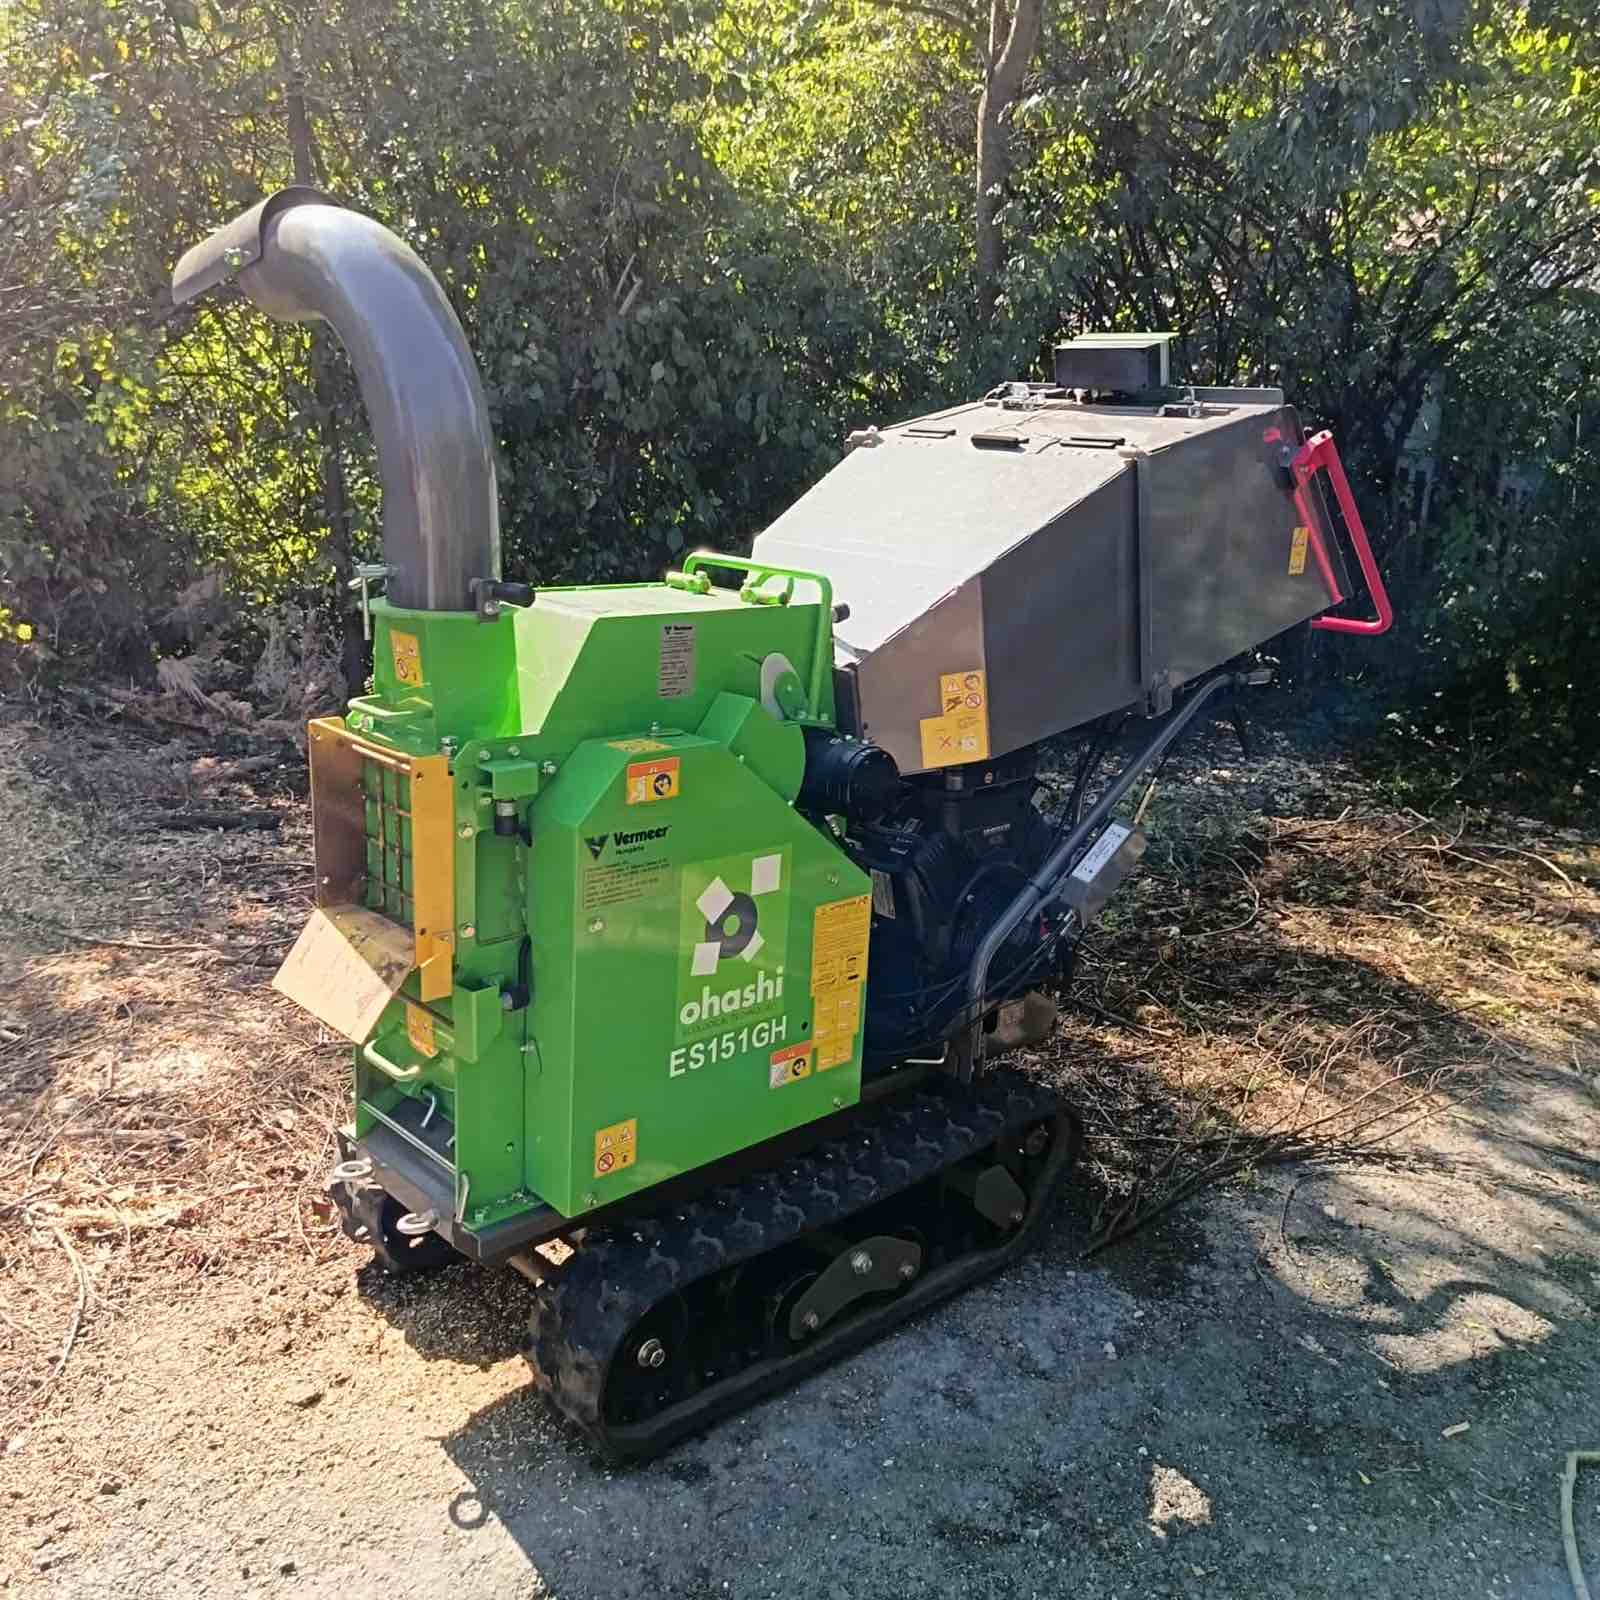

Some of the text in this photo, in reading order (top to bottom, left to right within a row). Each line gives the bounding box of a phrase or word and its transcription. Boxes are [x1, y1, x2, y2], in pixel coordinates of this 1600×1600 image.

[613, 826, 669, 846] Vermeer
[680, 966, 784, 1024] ohashi
[669, 1015, 787, 1078] ES151GH
